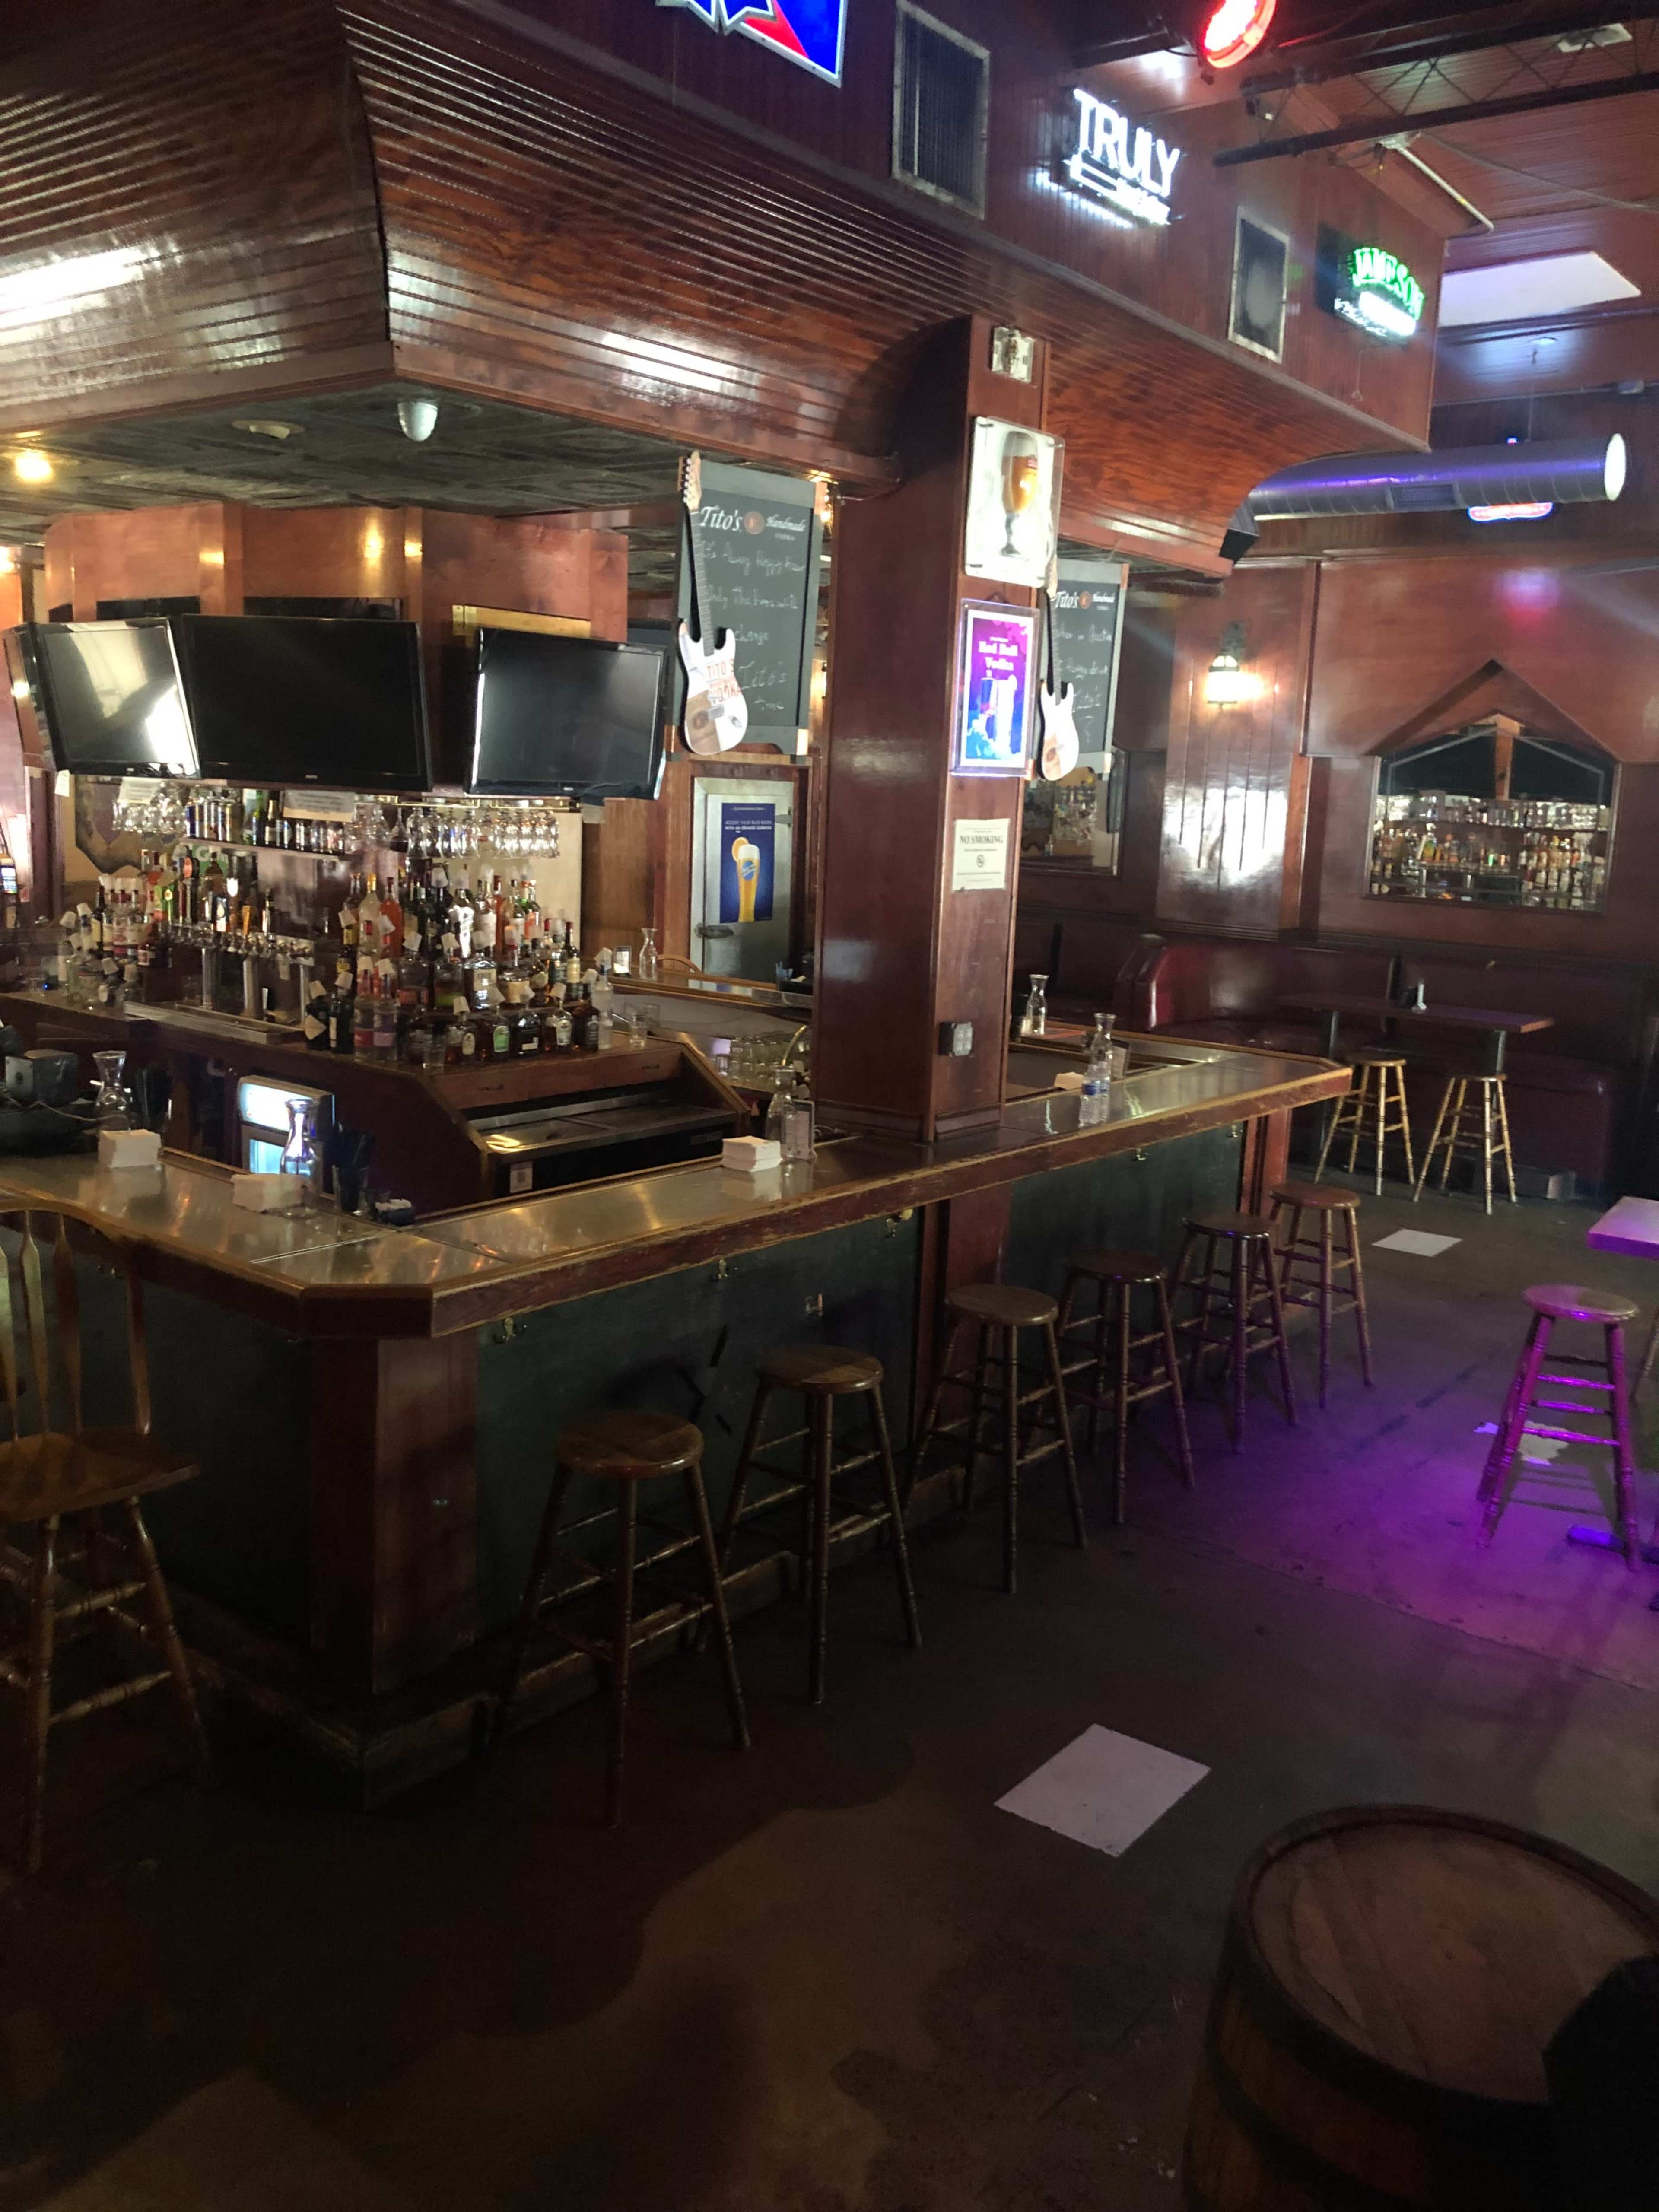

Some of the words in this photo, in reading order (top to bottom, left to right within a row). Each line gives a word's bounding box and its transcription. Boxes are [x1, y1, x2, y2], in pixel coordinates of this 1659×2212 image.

[1073, 88, 1180, 197] TRULY
[699, 505, 743, 531] Tito's
[1055, 590, 1079, 608] Tito's
[960, 835, 970, 844] NO
[971, 835, 1004, 844] SMOKING
